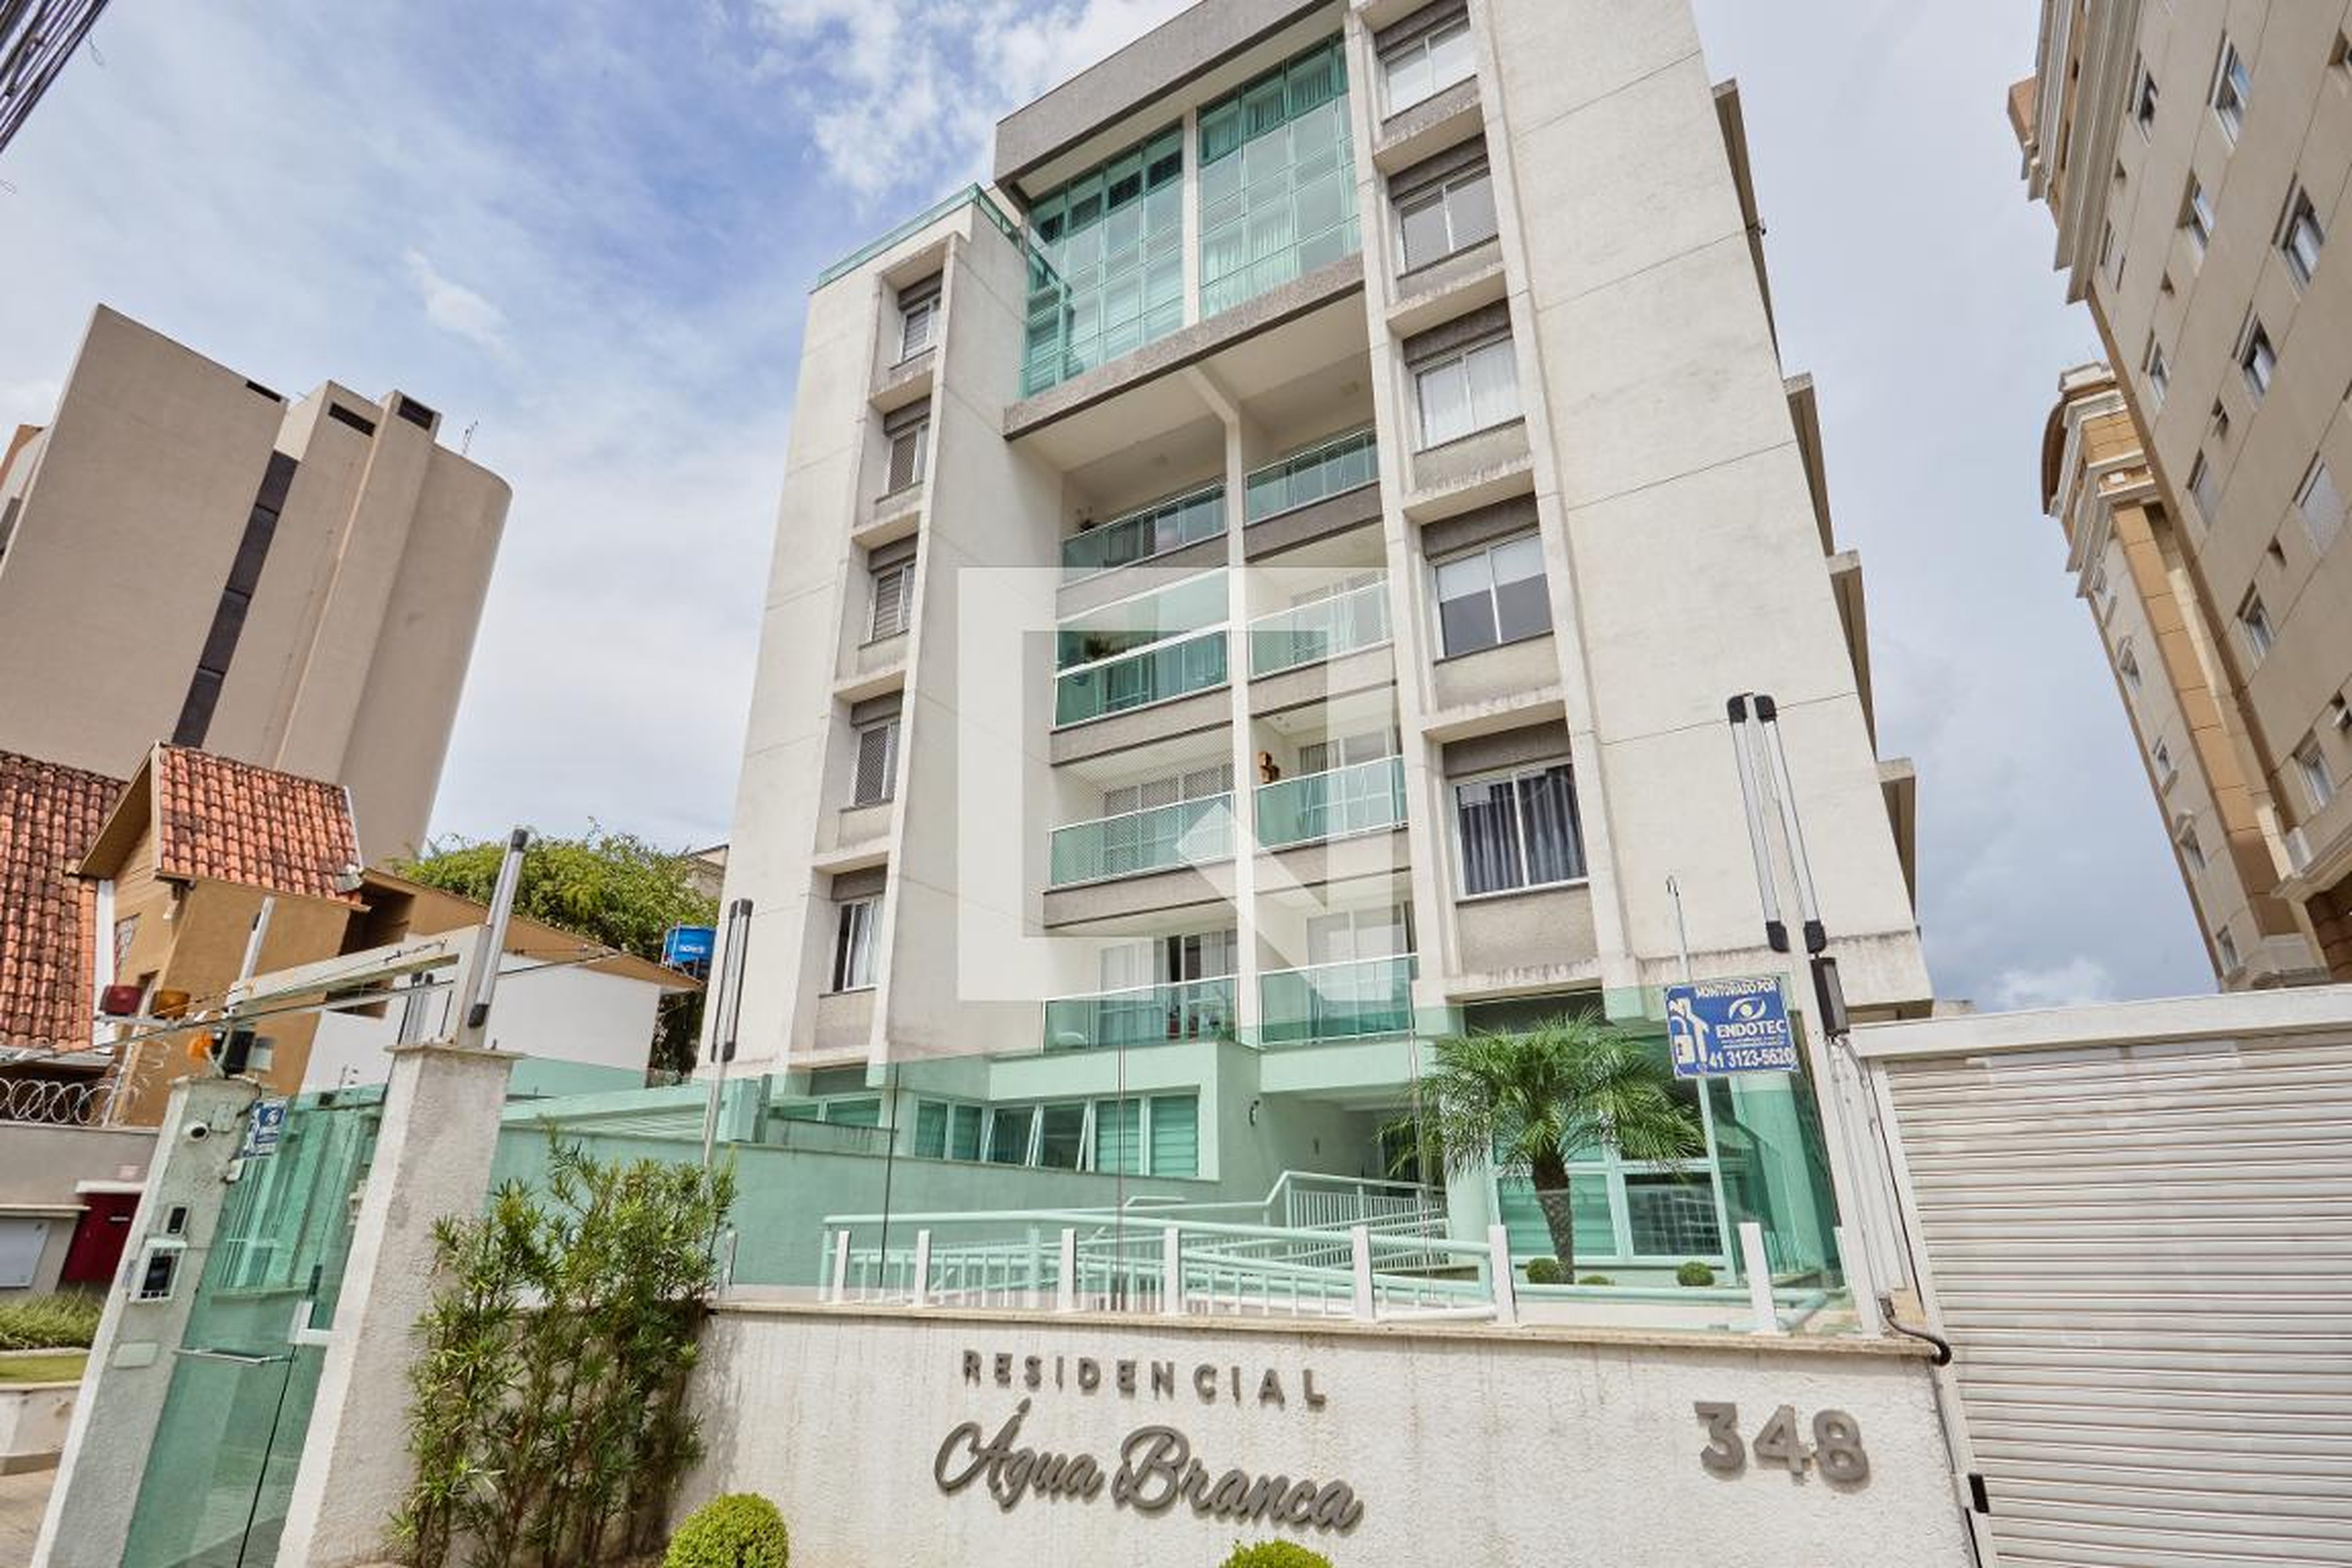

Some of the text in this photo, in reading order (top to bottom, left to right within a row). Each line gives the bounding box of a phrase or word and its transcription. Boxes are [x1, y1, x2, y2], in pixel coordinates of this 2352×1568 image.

[1709, 1051, 1724, 1068] 41
[1716, 1020, 1787, 1038] ENDOTEC
[963, 1348, 1328, 1409] RESIDENCIAL
[934, 1396, 1365, 1530] Água Branca
[1695, 1401, 1869, 1481] 348
